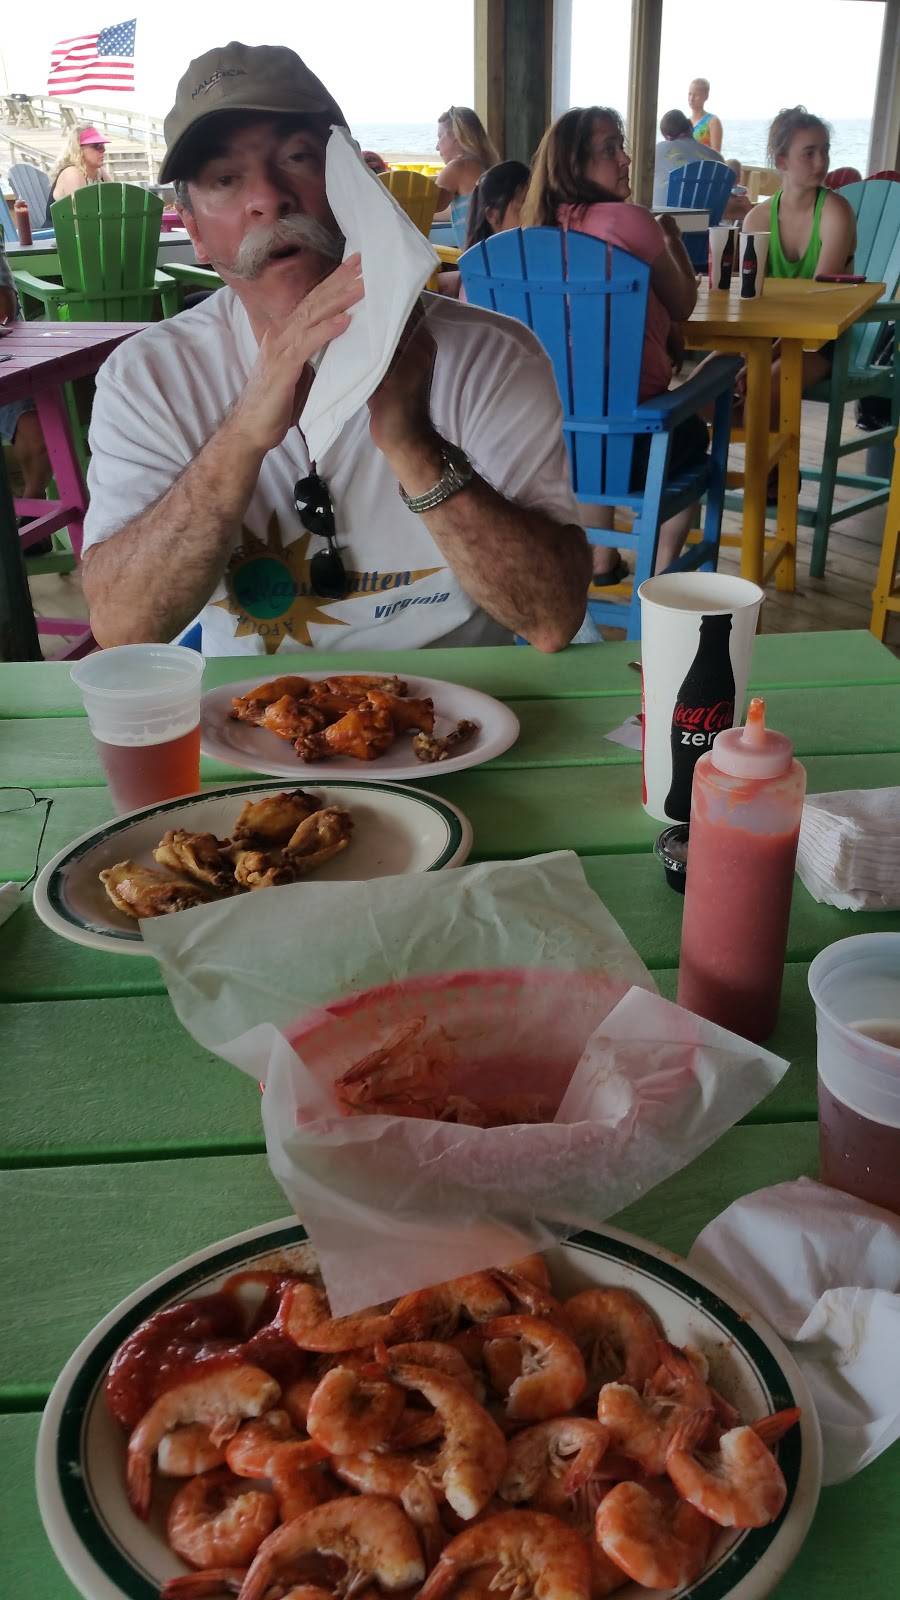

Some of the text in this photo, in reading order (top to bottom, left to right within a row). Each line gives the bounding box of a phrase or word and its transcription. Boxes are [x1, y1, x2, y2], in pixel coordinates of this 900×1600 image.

[192, 70, 247, 99] NAUTICA
[374, 592, 450, 619] Virginia
[681, 731, 716, 747] zer
